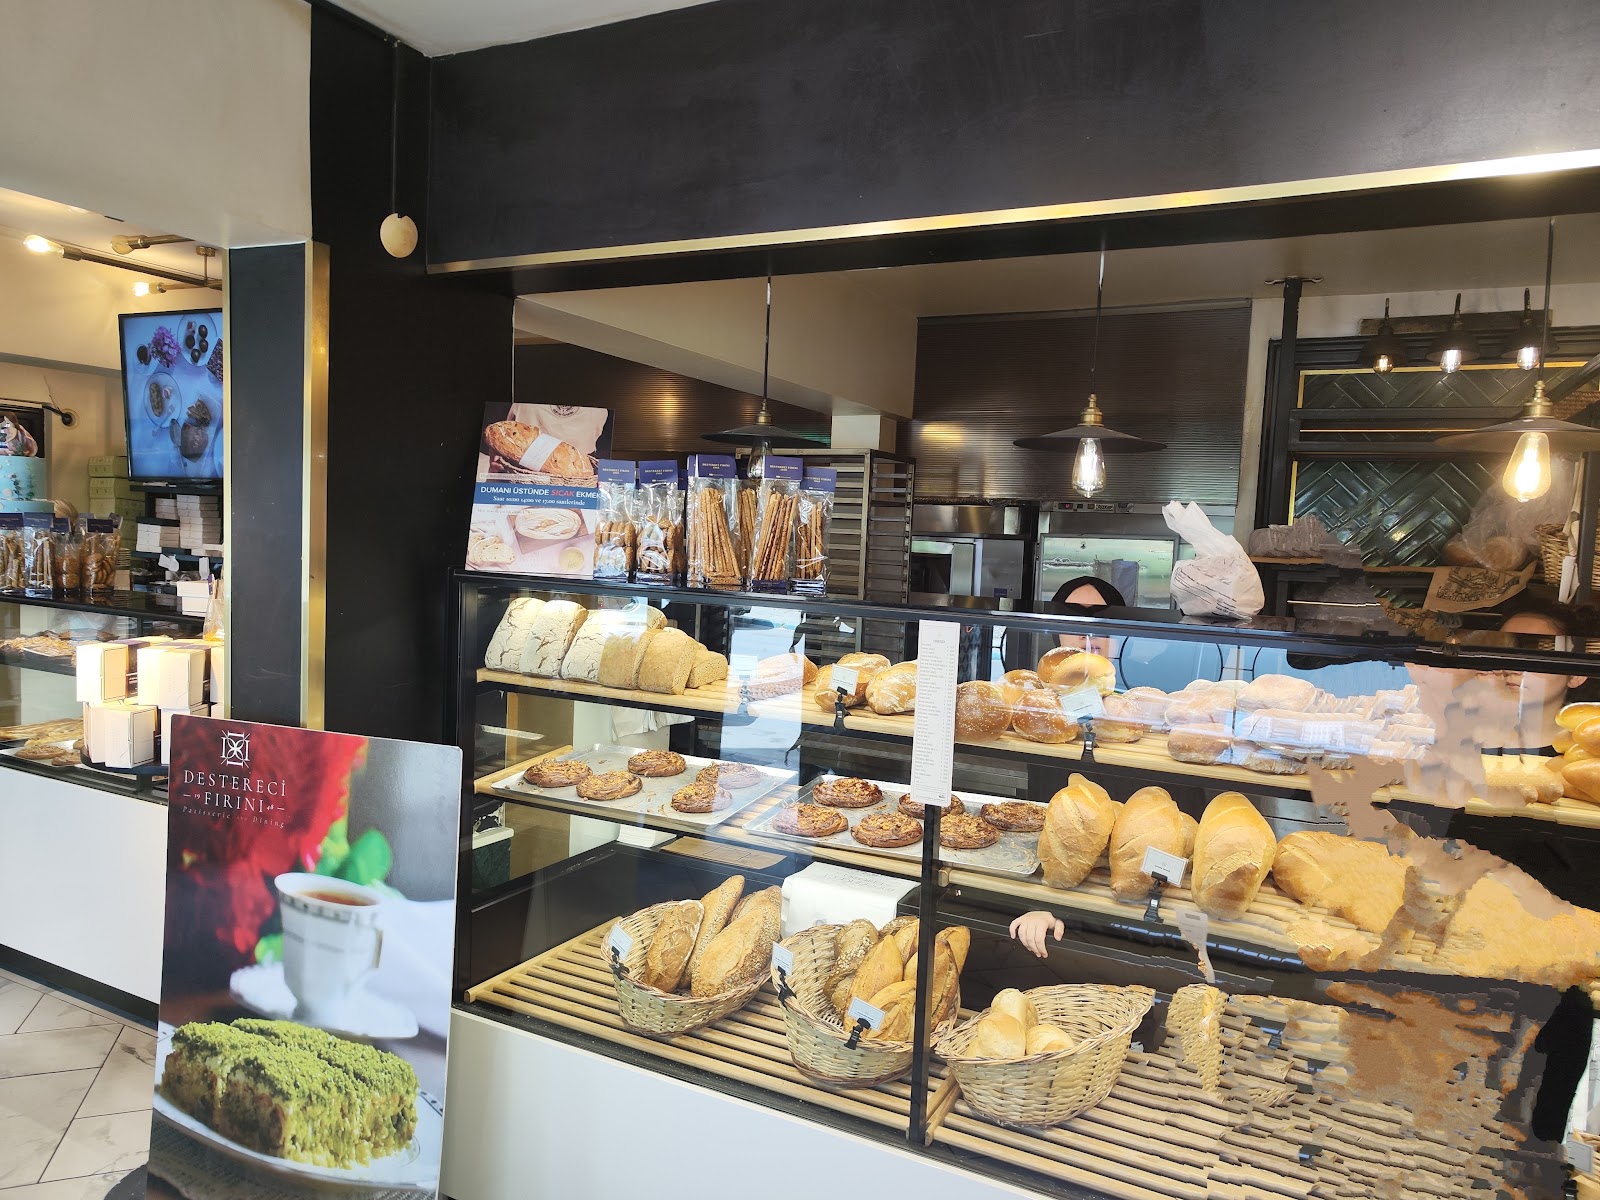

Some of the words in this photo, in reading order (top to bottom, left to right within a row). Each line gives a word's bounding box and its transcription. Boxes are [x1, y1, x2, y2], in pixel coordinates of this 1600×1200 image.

[480, 486, 511, 494] DUMANI
[513, 486, 550, 496] ÜSTÜNDE
[551, 489, 575, 497] SICAK
[184, 769, 286, 797] DESTERECİ
[204, 791, 264, 813] FIRINI
